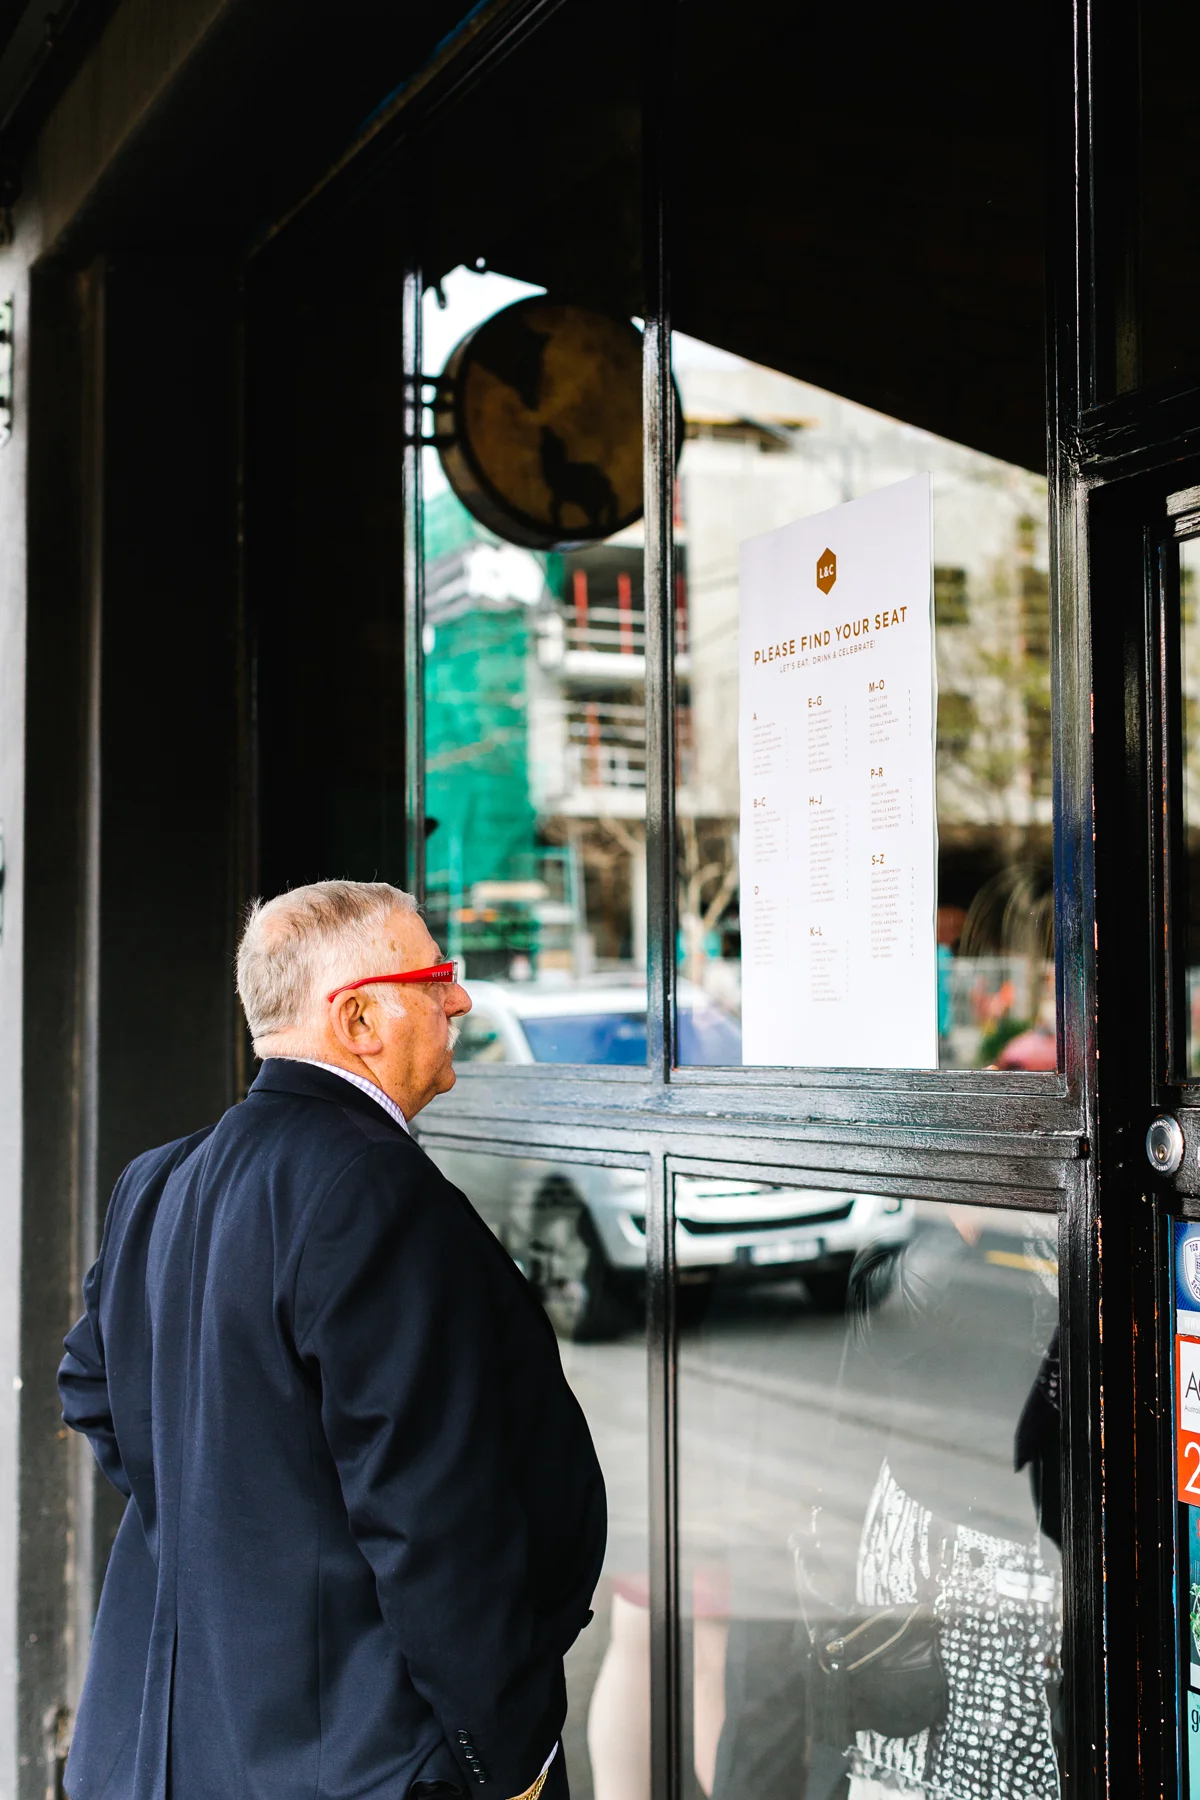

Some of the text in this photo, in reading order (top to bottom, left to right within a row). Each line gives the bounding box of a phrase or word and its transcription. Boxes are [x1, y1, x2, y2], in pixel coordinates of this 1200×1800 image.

[819, 564, 834, 579] L&C
[754, 606, 908, 665] PLEASE FIND YOUR SEAT
[779, 662, 795, 674] LET'S
[813, 654, 832, 665] DRINK
[838, 640, 876, 658] CELEBRATE!
[869, 679, 885, 693] M-O
[808, 695, 822, 708] E-G
[753, 712, 757, 721] A
[870, 767, 883, 779] P-R
[753, 797, 766, 808] B-C
[809, 795, 822, 806] H-J
[871, 853, 885, 865] S-Z
[754, 886, 759, 895] D
[810, 926, 823, 936] K-L
